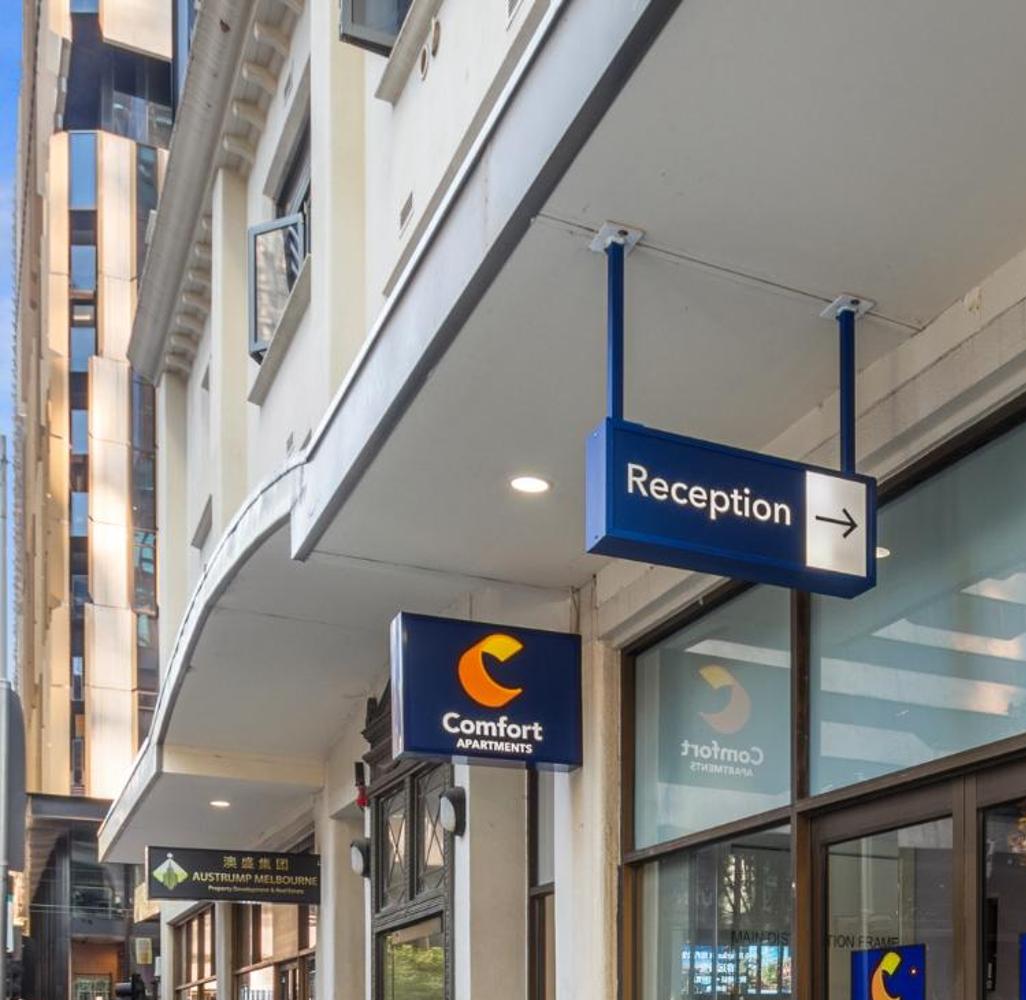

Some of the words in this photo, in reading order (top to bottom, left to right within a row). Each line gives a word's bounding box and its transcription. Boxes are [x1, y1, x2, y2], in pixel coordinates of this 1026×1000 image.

[626, 462, 792, 527] Reception
[442, 712, 543, 740] Comfort
[456, 738, 533, 754] APARTMENTS
[192, 871, 252, 882] AUSTRUMP
[254, 874, 318, 886] MELBOURNE
